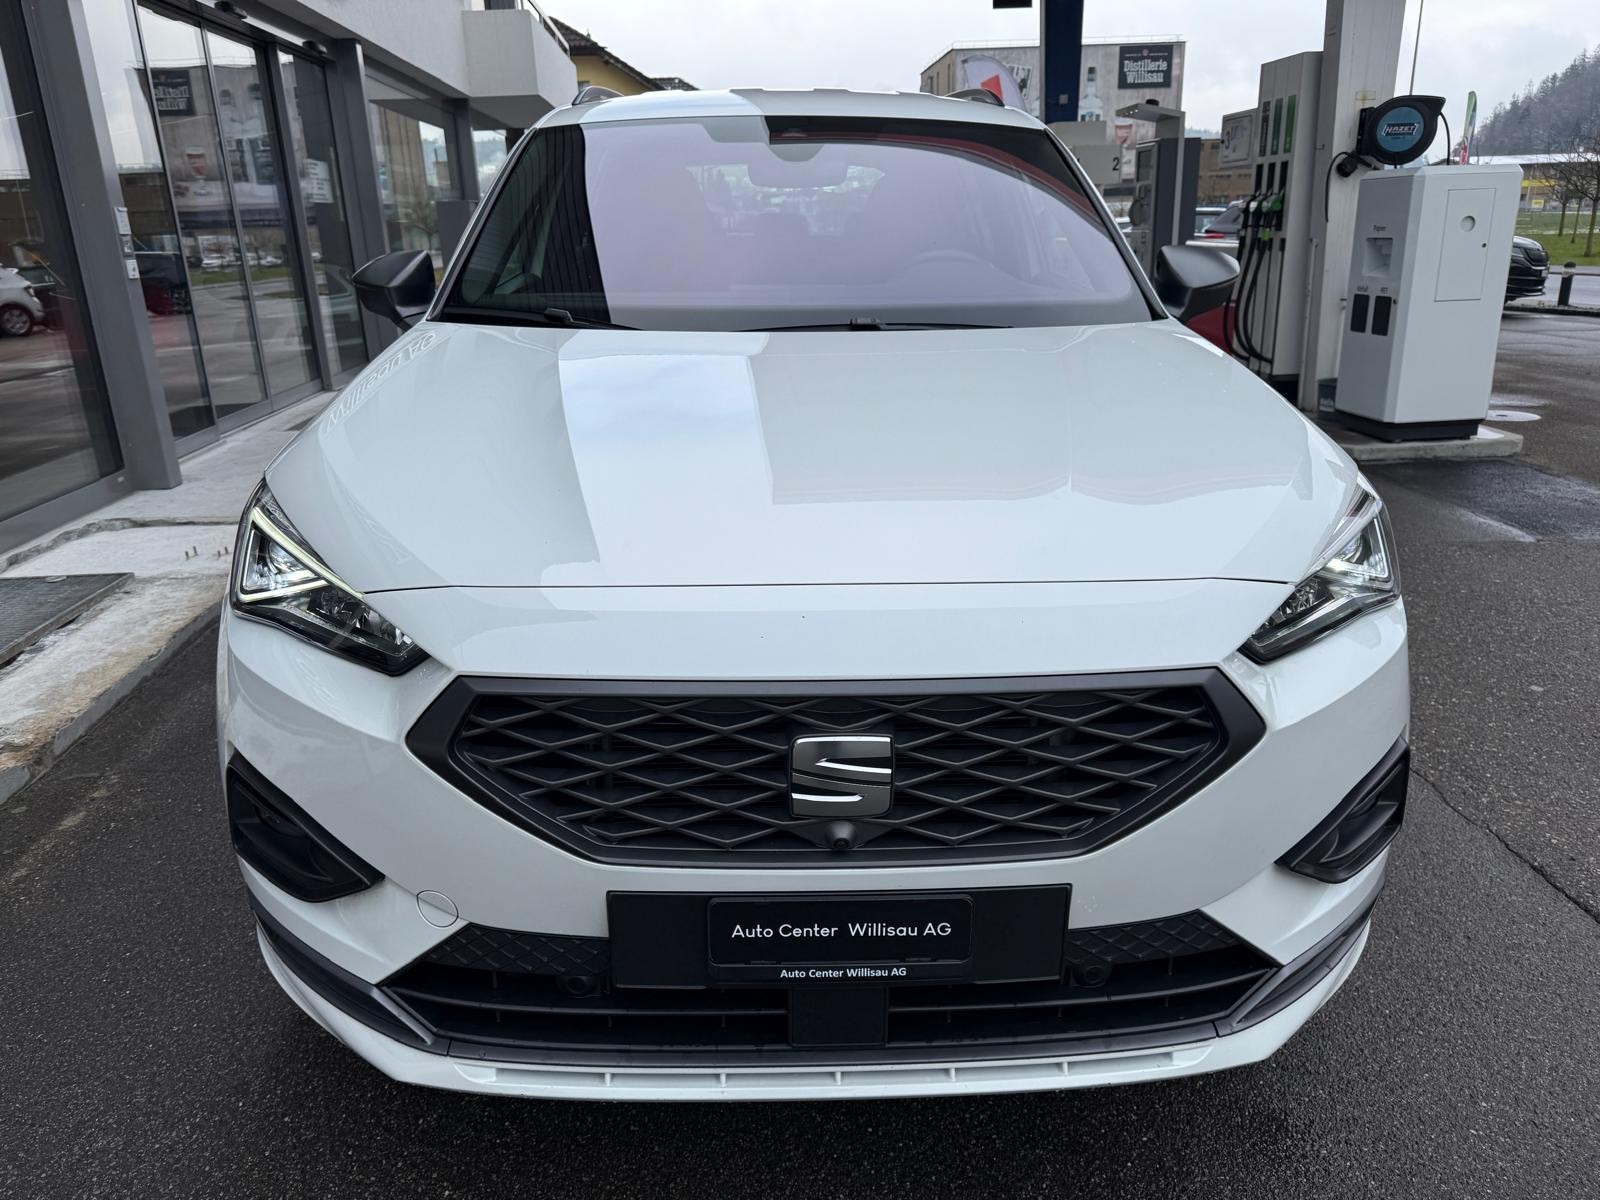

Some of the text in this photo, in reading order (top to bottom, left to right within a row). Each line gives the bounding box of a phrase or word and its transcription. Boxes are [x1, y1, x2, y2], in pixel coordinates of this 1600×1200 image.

[1123, 58, 1168, 72] Distillerie
[1126, 71, 1164, 83] Willisau
[1384, 125, 1416, 135] HAZET
[1111, 157, 1121, 172] 2
[731, 922, 952, 939] Auto Center Willisau AG
[779, 967, 908, 978] Auto Center Willisau AG
